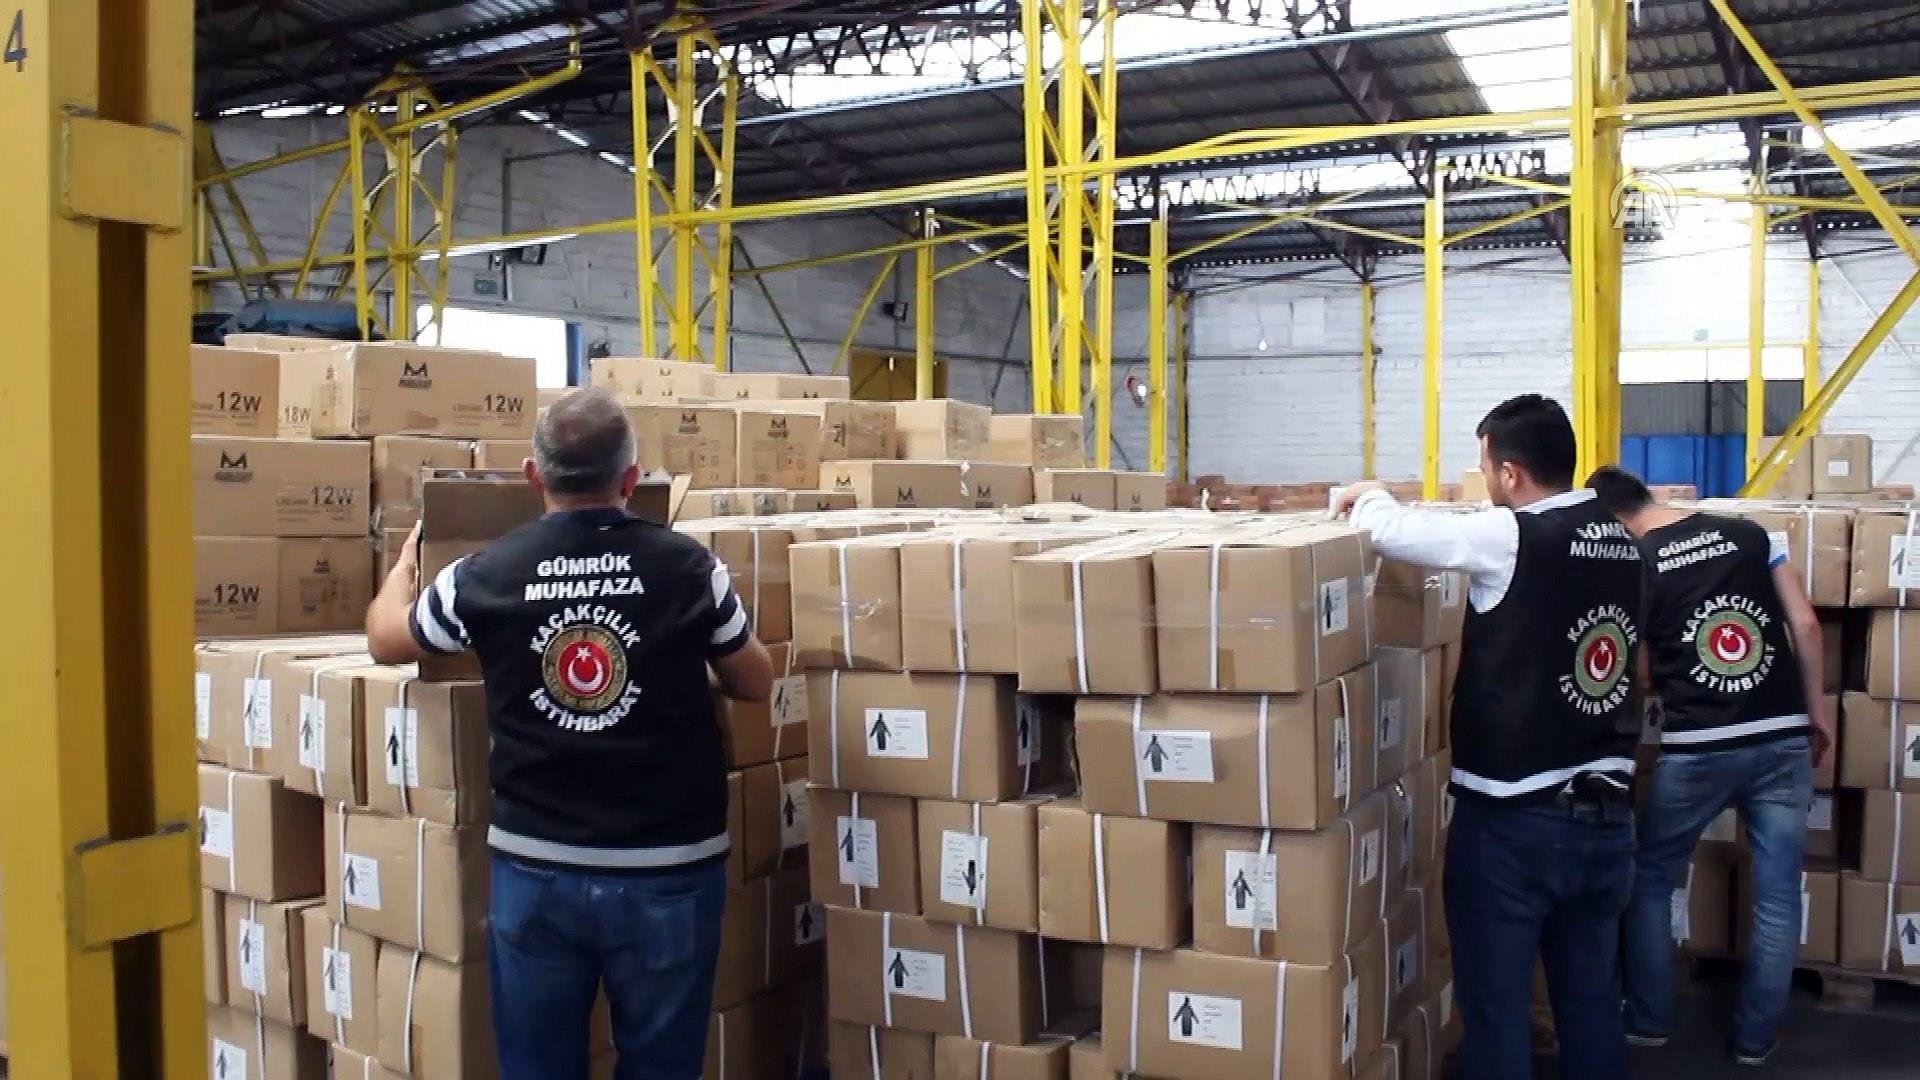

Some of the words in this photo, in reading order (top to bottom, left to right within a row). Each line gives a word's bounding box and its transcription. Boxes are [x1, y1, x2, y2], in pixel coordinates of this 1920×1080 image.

[4, 10, 28, 72] 4
[217, 390, 262, 413] 12W
[284, 404, 312, 424] 18W
[484, 393, 524, 413] 12W
[311, 486, 354, 505] 12W
[1658, 530, 1723, 557] GÜMRÜK
[536, 552, 632, 577] GÜMRÜK
[1657, 542, 1738, 573] MUHAFAZA
[214, 583, 260, 604] 12W
[523, 576, 645, 601] MUHAFAZA
[530, 603, 641, 654] KAÇAKÇILIK
[1567, 603, 1638, 647] KAÇAKÇILIK
[1681, 594, 1771, 642] KAÇAKÇILIK
[1689, 644, 1775, 692] İSTİHBARAT
[1559, 673, 1631, 715] İSTİHBARAT
